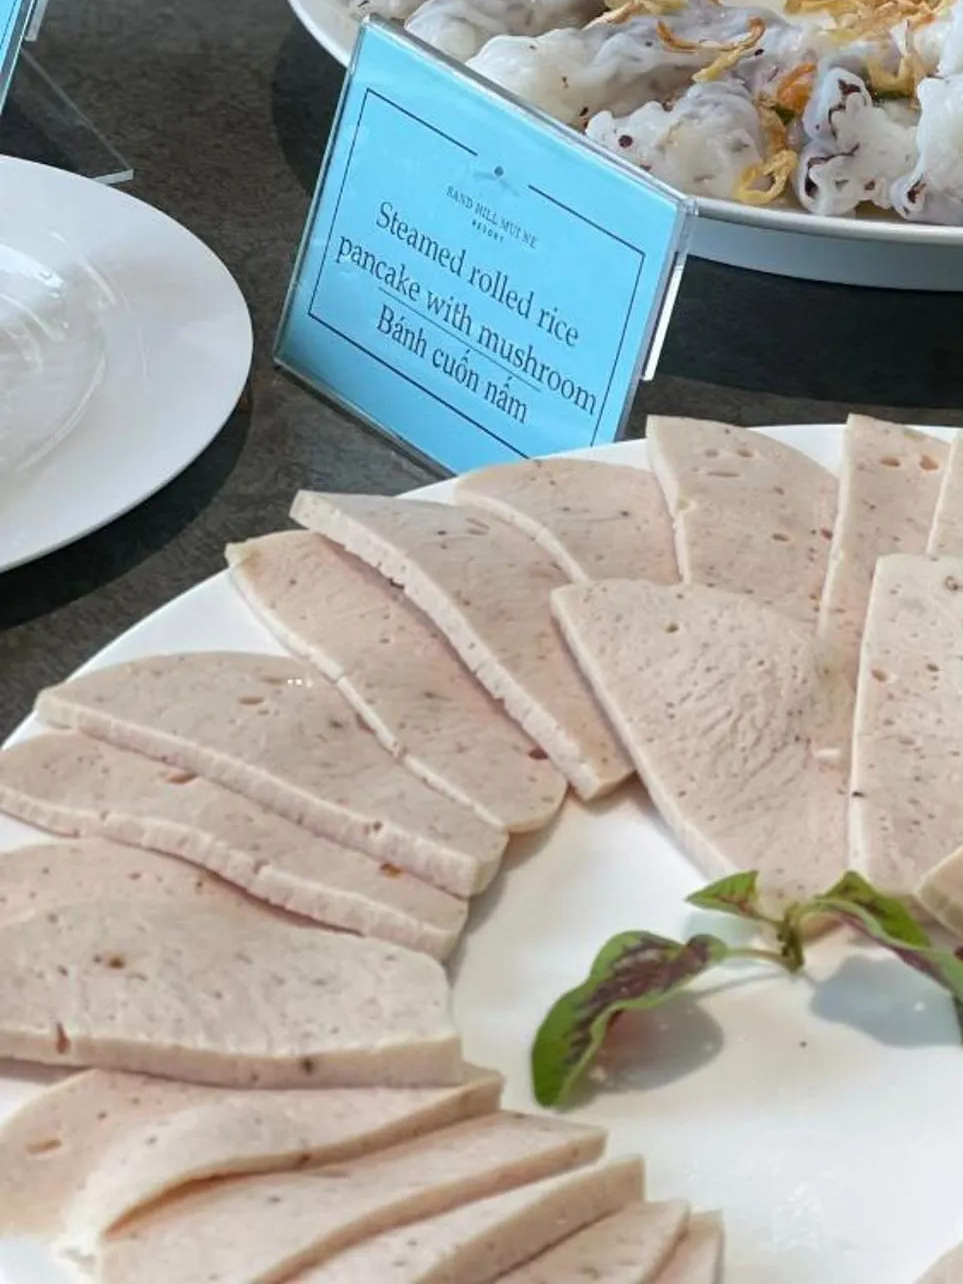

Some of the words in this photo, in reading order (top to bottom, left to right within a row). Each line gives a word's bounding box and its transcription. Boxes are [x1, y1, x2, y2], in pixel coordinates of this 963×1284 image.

[336, 235, 421, 302] pancake
[427, 290, 472, 337] with
[477, 324, 597, 416] mushroom
[376, 201, 466, 277] Steamed
[467, 265, 534, 319] rolled
[536, 307, 579, 348] rice
[377, 303, 428, 359] Bánh
[431, 348, 480, 394] cuốn
[483, 375, 528, 424] nấm
